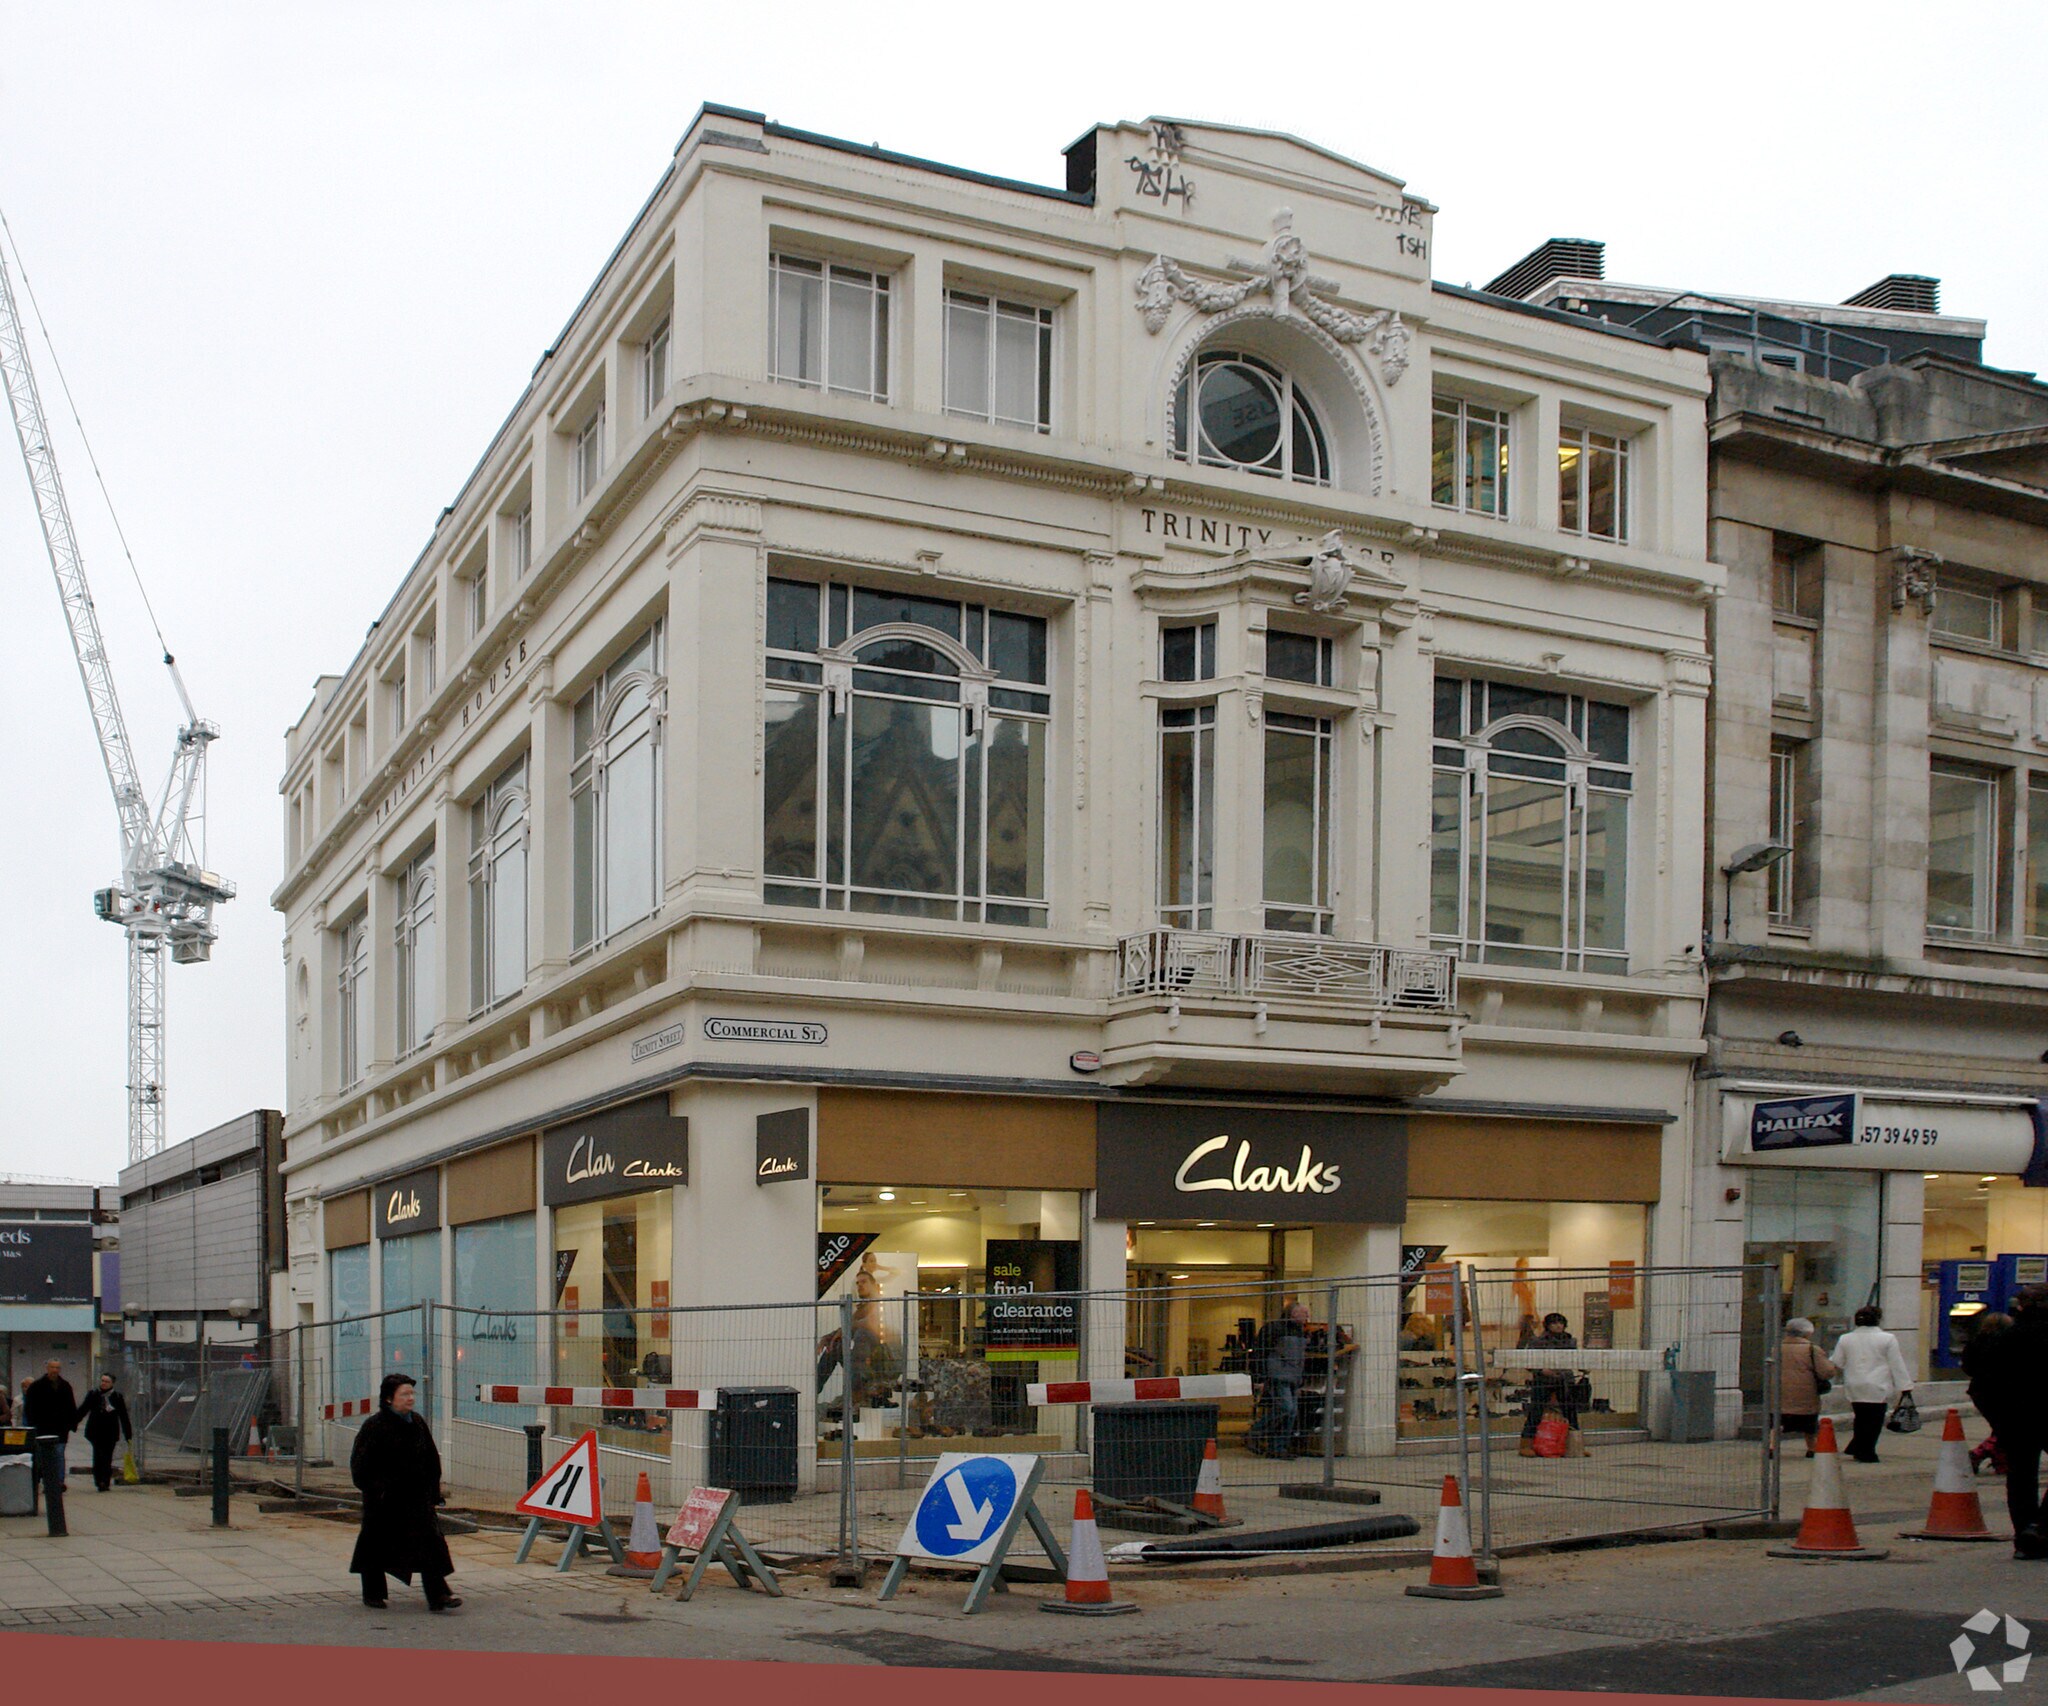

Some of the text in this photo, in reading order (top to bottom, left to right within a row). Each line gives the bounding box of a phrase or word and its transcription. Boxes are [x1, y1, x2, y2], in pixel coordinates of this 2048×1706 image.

[1396, 233, 1427, 260] TSH
[1141, 508, 1272, 548] TRINITY
[375, 639, 527, 826] TRINITY HOUSE
[710, 1021, 822, 1041] COMMERCIAL ST.
[1756, 1112, 1845, 1133] HALIFAX
[1860, 1126, 1938, 1145] 57 39 49 59
[566, 1134, 616, 1185] Clar
[622, 1159, 683, 1177] Clarks
[758, 1156, 799, 1176] Clarks
[1174, 1134, 1342, 1194] Clarks
[387, 1189, 421, 1225] Clarks
[818, 1235, 850, 1270] sale
[1401, 1247, 1427, 1277] sale
[993, 1262, 1021, 1276] sale
[993, 1280, 1034, 1296] final
[993, 1301, 1073, 1318] clearance
[472, 1305, 518, 1342] Clarks
